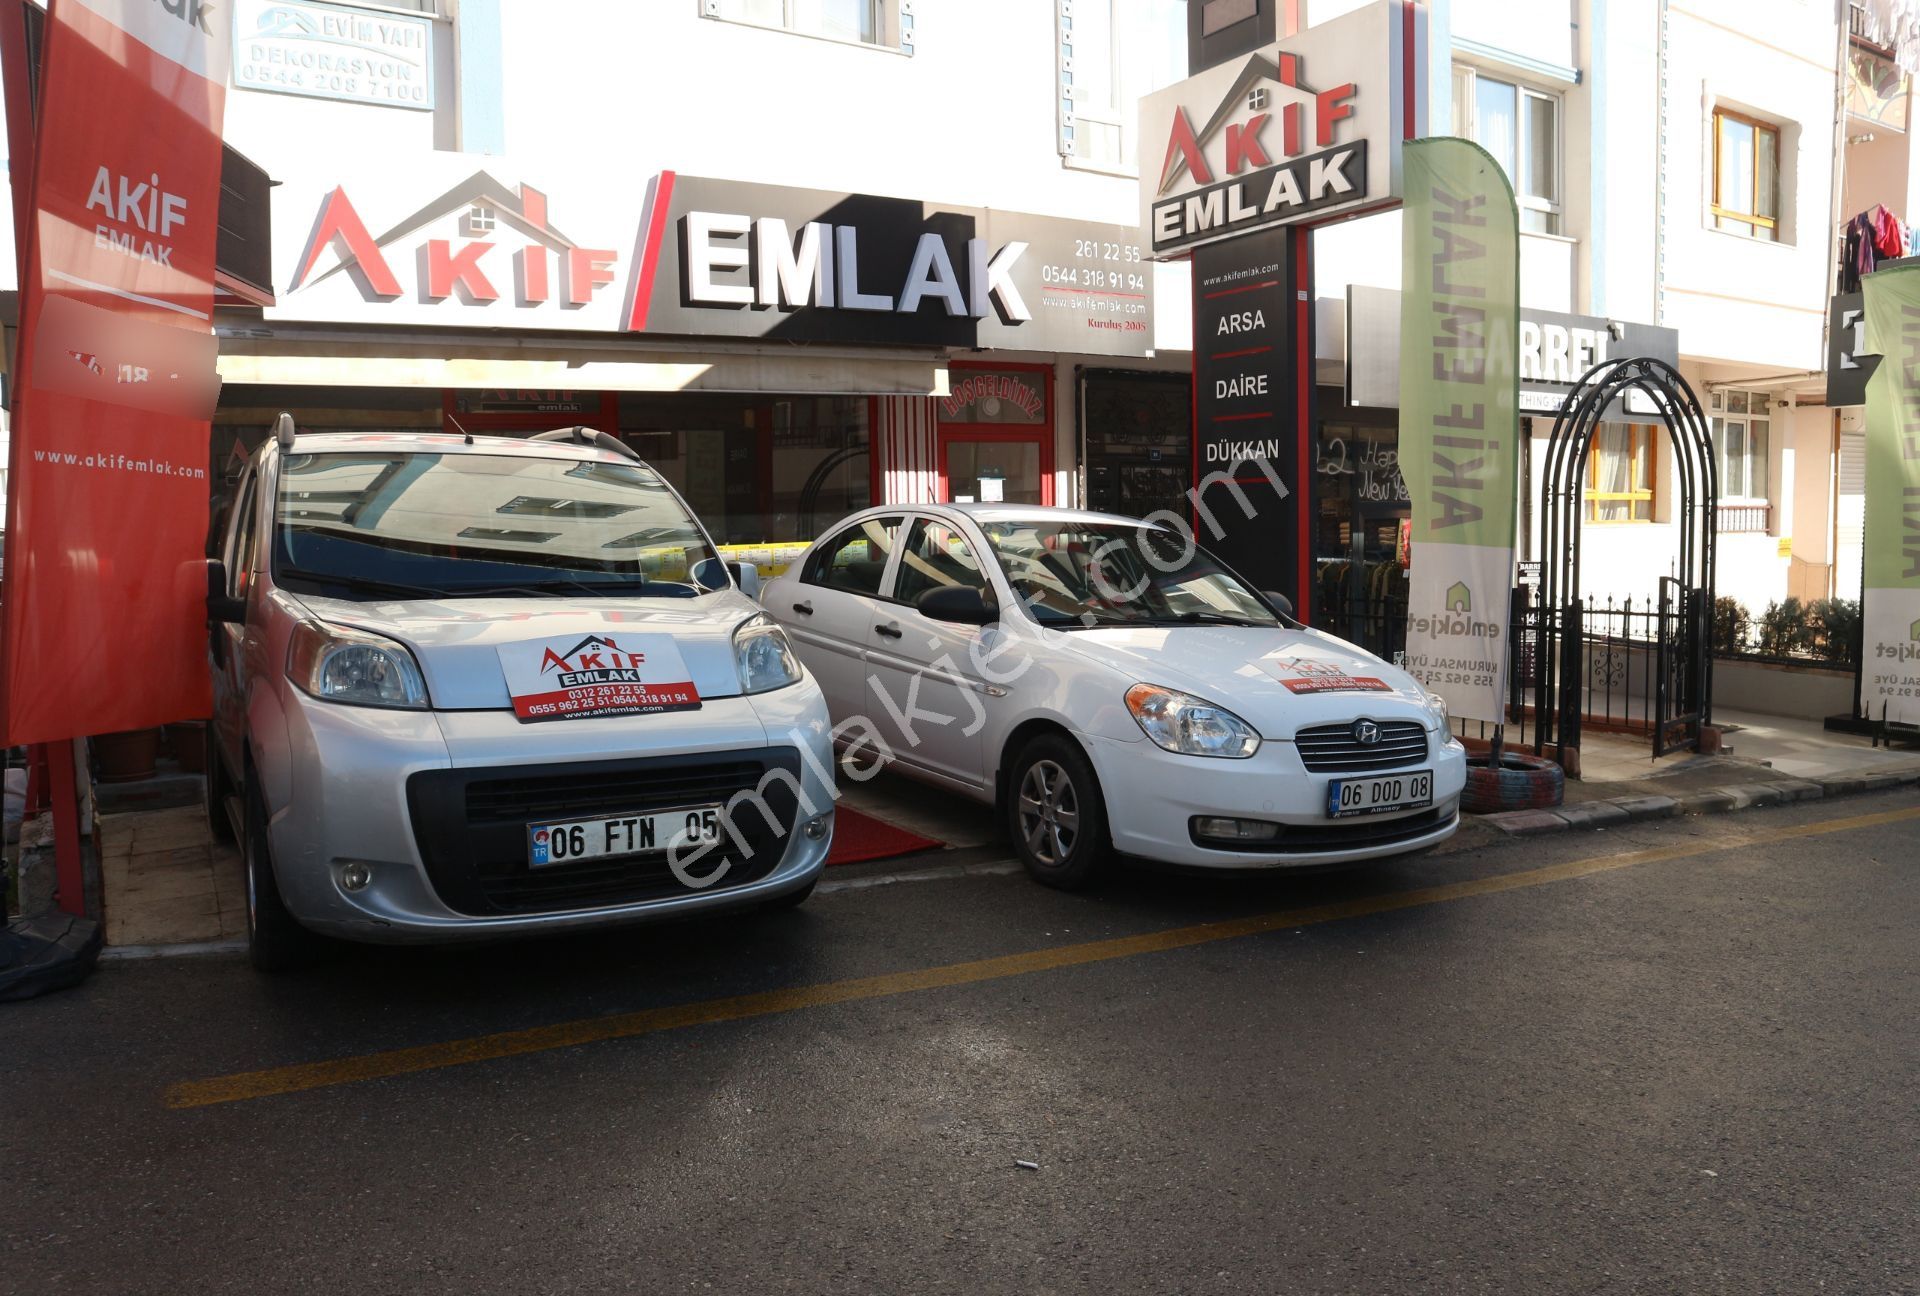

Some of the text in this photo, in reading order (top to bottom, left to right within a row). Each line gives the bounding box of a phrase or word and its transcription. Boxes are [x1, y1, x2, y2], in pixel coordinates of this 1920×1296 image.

[323, 14, 423, 49] EVİM YAPI
[250, 44, 413, 81] DEKORASYON
[242, 64, 304, 86] 0544
[368, 80, 424, 101] 7100
[86, 165, 187, 237] AKİF
[1154, 149, 1354, 243] EMLAK
[95, 224, 173, 269] EMLAK
[1075, 239, 1141, 263] 261 22 55
[680, 210, 1033, 322] EMLAK
[1042, 265, 1145, 290] 0544 318 91 94
[1203, 263, 1280, 287] www.akifemlak.com
[1042, 296, 1146, 314] www.akifemlak.com
[1087, 318, 1147, 332] Kuruluş 2005
[1217, 309, 1267, 336] ARSA
[943, 374, 1042, 418] HOŞGELDİNİZ
[1216, 373, 1269, 399] DAİRE
[537, 403, 579, 412] emlak
[1206, 438, 1280, 462] DÜKKAN
[33, 450, 205, 479] www.akifemlak.com
[561, 669, 639, 687] EMLAK
[528, 692, 688, 715] 0555 962 25 51-0544 318 91 94
[568, 685, 647, 700] 0312 261 22 55
[564, 704, 665, 719] www.akifemlak.com
[1341, 784, 1362, 806] 06
[1410, 776, 1428, 798] 08
[533, 810, 718, 859] TR 06 FTN 05
